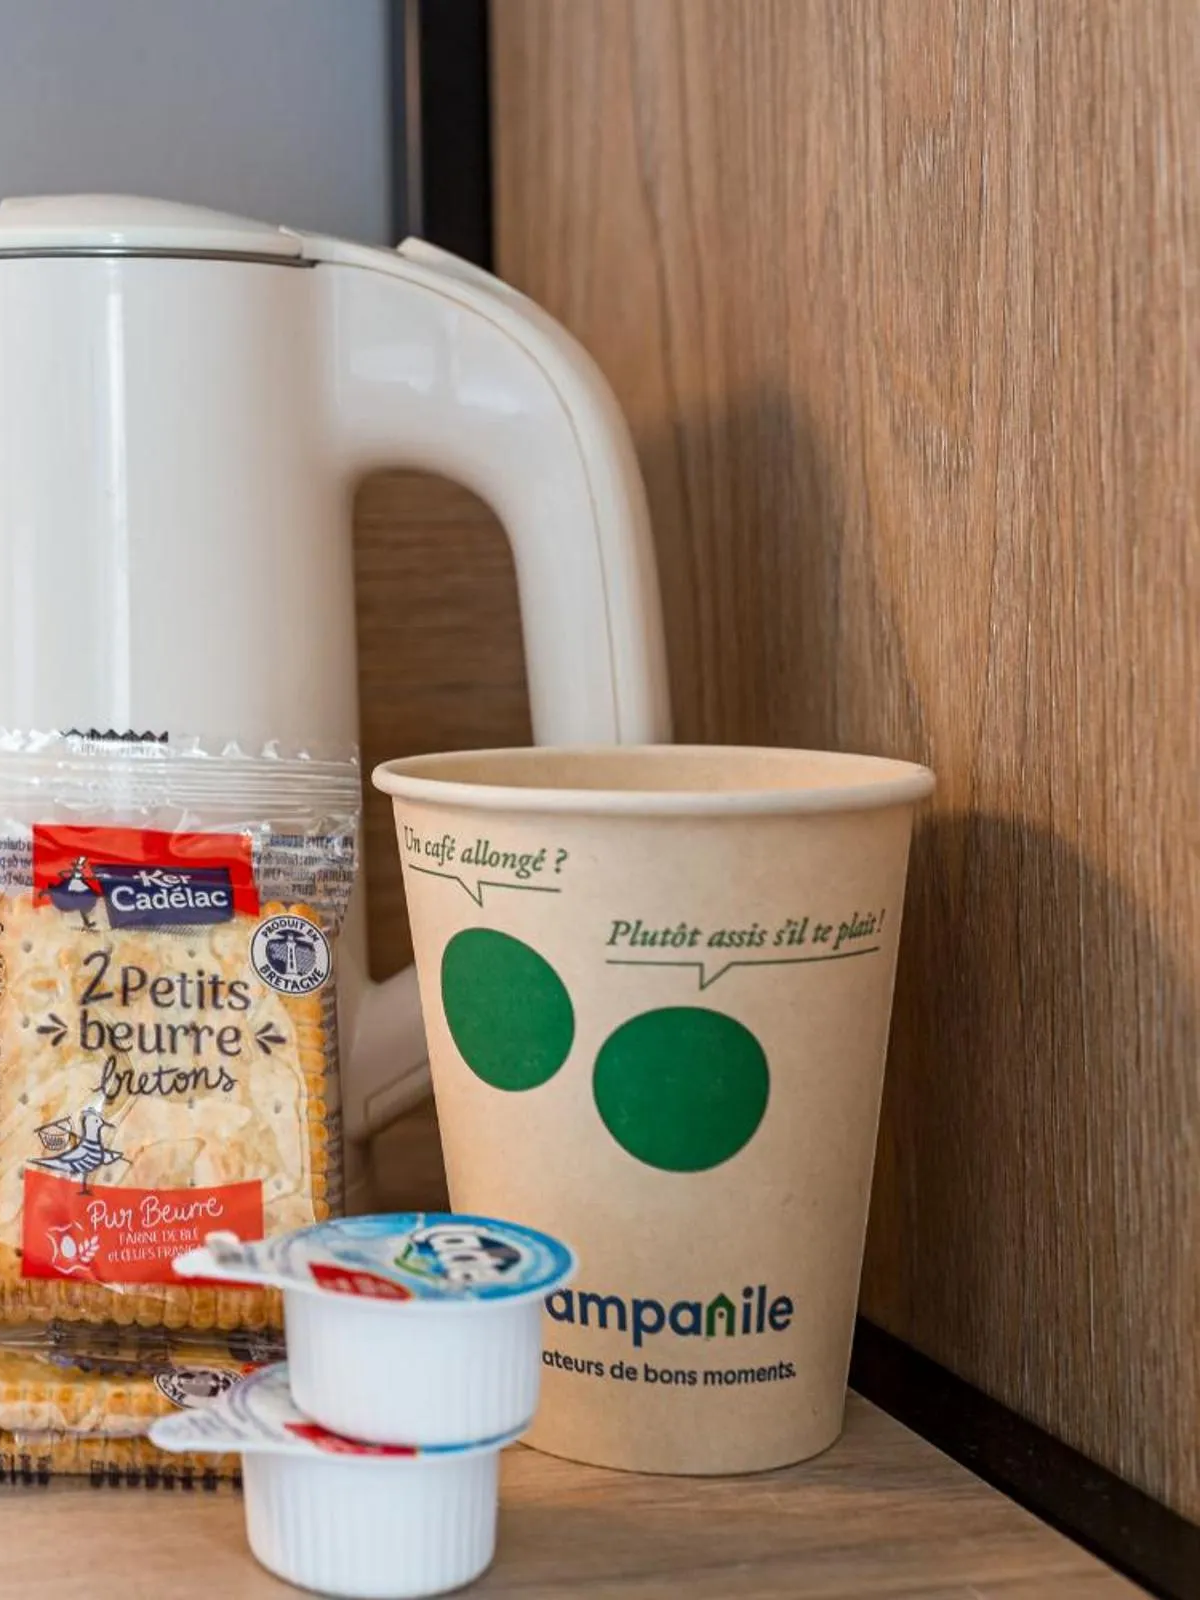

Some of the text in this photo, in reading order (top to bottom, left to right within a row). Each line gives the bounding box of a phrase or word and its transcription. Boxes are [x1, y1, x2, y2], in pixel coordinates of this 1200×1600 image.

[403, 825, 422, 855] Un
[424, 837, 456, 867] café
[460, 841, 546, 880] allongé
[133, 869, 191, 887] Ker
[111, 885, 228, 911] Cadélac
[261, 919, 305, 937] PRODUIT
[606, 919, 701, 948] Plutôt
[707, 922, 767, 949] assis
[812, 923, 833, 944] te
[80, 948, 251, 1011] 2 Petits
[260, 964, 324, 991] BRETAGNE
[80, 1011, 243, 1057] beurre
[95, 1055, 238, 1100] bretons
[86, 1195, 224, 1231] Pur Beurre
[544, 1285, 794, 1348] ampanile
[542, 1350, 796, 1386] ateurs de bons moments.
